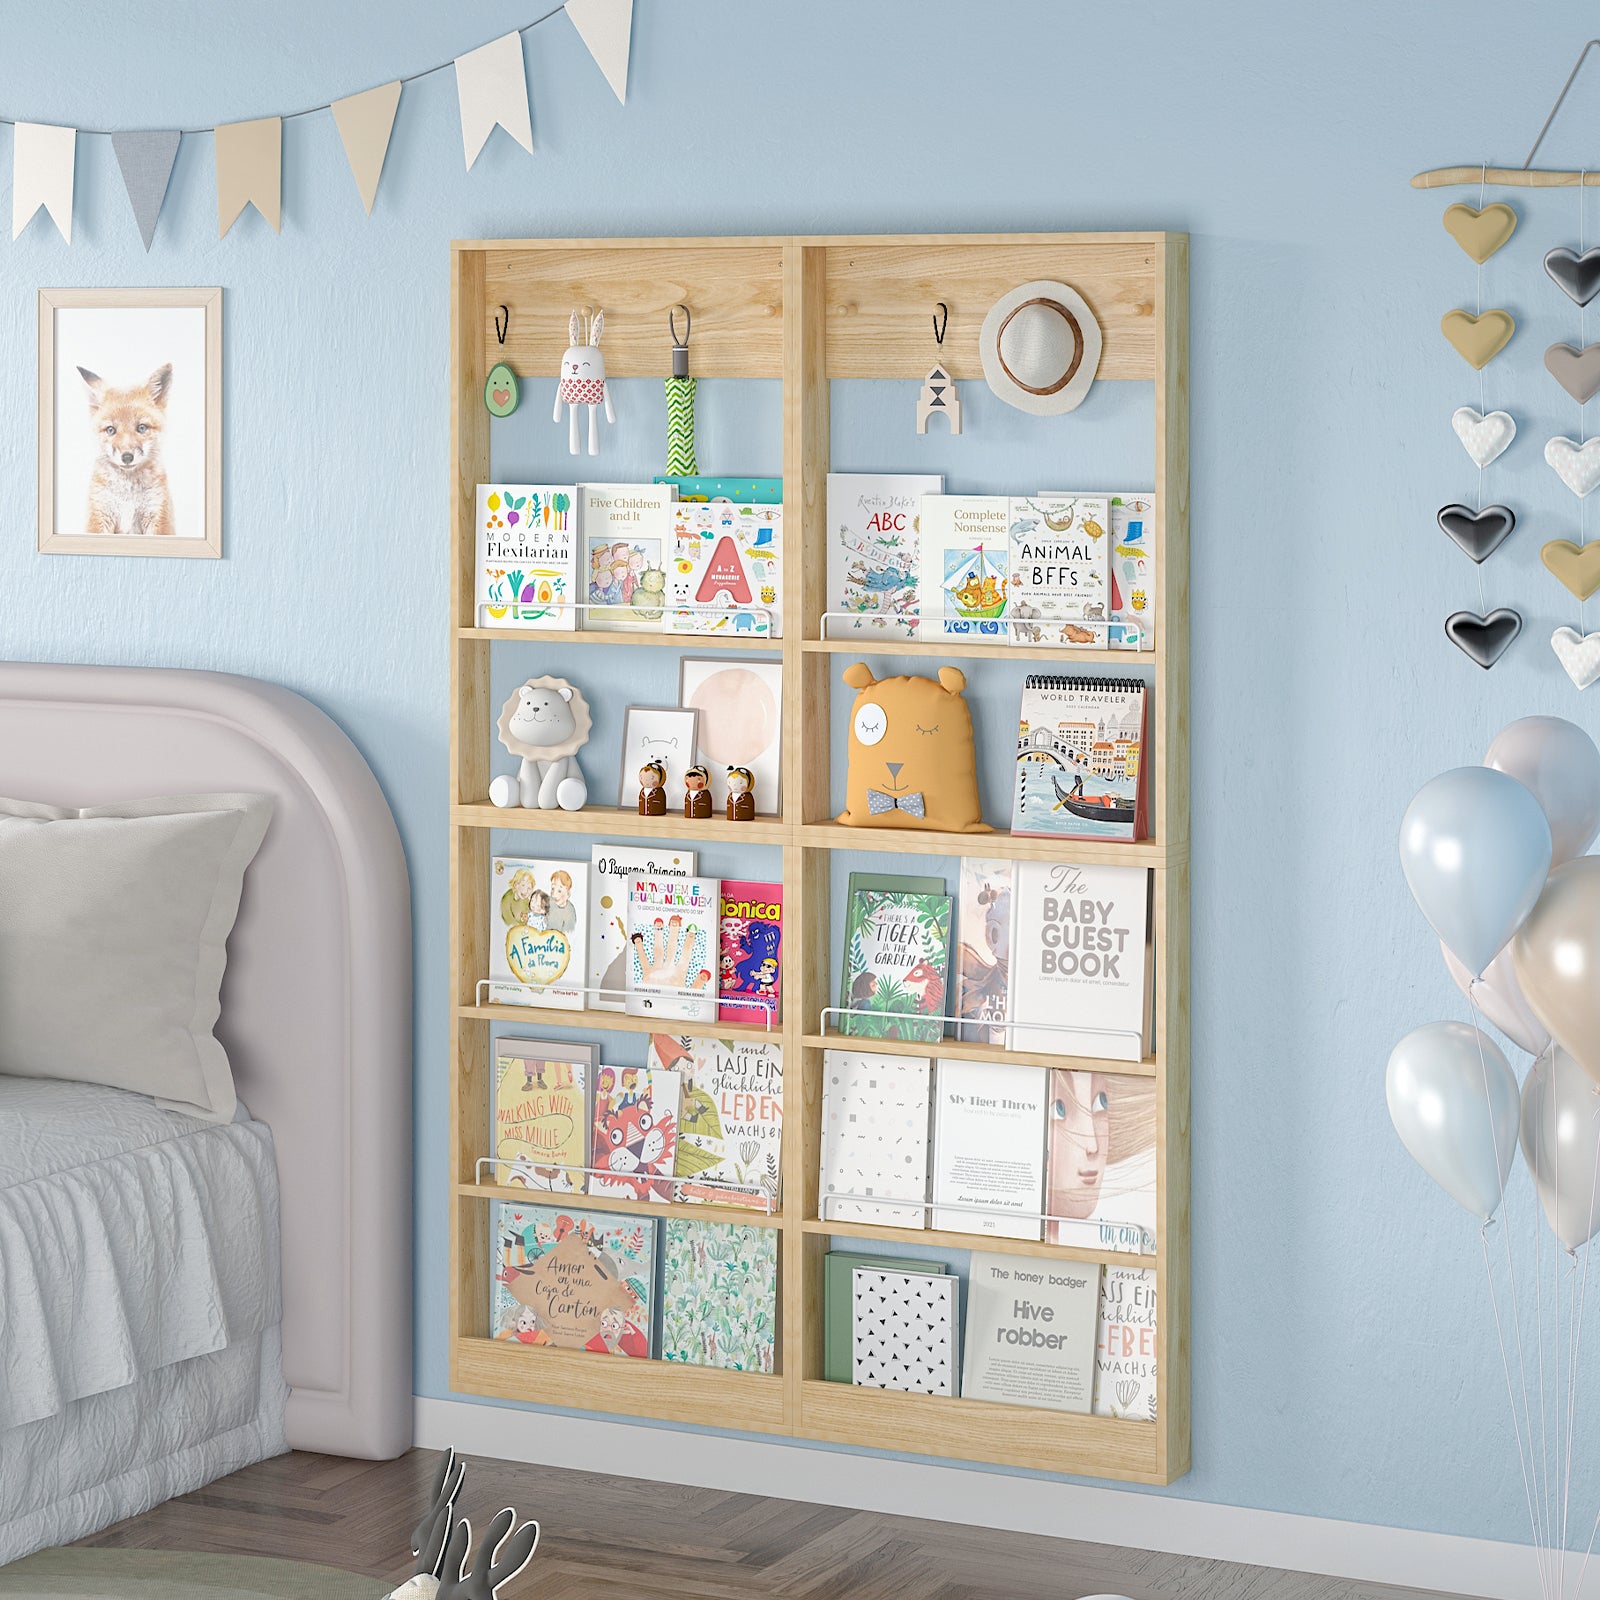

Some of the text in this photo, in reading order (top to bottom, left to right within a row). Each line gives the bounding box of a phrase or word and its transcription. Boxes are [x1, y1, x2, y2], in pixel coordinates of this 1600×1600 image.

[590, 498, 661, 509] Five Children
[609, 511, 641, 521] and It
[866, 512, 907, 532] ABC
[954, 509, 1006, 522] Complete
[486, 532, 569, 543] MODERN
[954, 522, 1007, 533] Nonsense
[487, 542, 568, 559] Flexitarian
[730, 565, 735, 573] Z
[1032, 566, 1078, 586] BFFs
[1040, 693, 1126, 703] WORLD TRAVELER
[598, 858, 607, 874] O
[1043, 864, 1088, 895] The
[911, 916, 916, 924] A
[1043, 897, 1114, 925] BABY
[875, 923, 920, 945] TIGER
[1041, 923, 1130, 953] GUEST
[509, 944, 523, 969] A
[882, 943, 907, 953] IN THE
[874, 952, 916, 967] GARDEN
[1041, 949, 1120, 979] BOOK
[738, 1043, 770, 1056] und
[716, 1054, 748, 1075] LASS
[497, 1094, 574, 1123] WALKING WITH
[721, 1092, 783, 1122] LEBEN
[949, 1093, 1038, 1111] Sly Tiger Throw
[504, 1125, 559, 1147] MISS MILLIE
[547, 1256, 585, 1276] Amor
[1111, 1268, 1150, 1281] und
[557, 1276, 592, 1287] en una
[990, 1267, 1088, 1289] The honey badger
[535, 1280, 575, 1300] Caja de
[548, 1294, 601, 1319] Cartón
[1013, 1299, 1055, 1322] Hive
[996, 1326, 1068, 1350] robber
